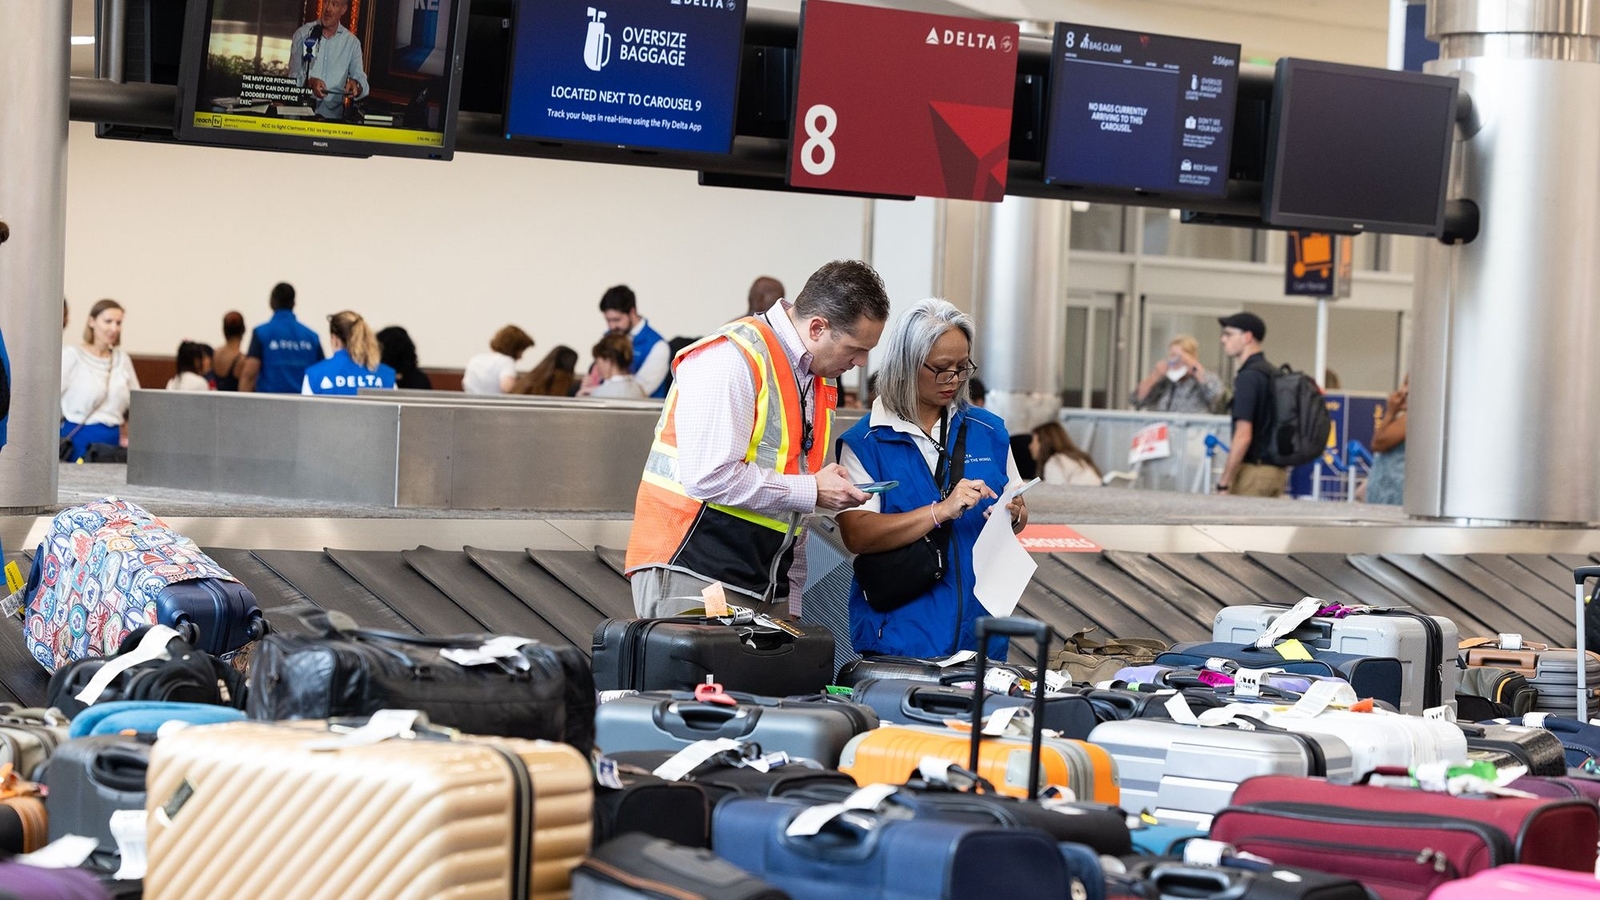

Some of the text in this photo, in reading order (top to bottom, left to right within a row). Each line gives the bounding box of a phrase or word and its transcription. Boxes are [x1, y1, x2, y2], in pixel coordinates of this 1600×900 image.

[622, 26, 686, 48] OVERSIZE
[944, 30, 996, 50] DELTA
[1066, 31, 1074, 48] 8
[620, 44, 686, 66] BAGGAGE
[1089, 41, 1122, 53] BAG CLAIM
[551, 86, 702, 112] LOCATED NEXT TO CAROUSEL 9
[1088, 102, 1148, 116] NO BAGS CURRENTLY
[547, 108, 565, 118] Track
[581, 112, 596, 122] bags
[597, 113, 603, 122] in
[604, 115, 632, 125] real-time
[633, 118, 650, 128] using
[650, 118, 660, 127] the
[662, 119, 671, 130] Fly
[672, 120, 688, 130] Delta
[688, 122, 702, 132] App
[1091, 112, 1143, 125] ARRIVING TO THIS
[800, 104, 838, 175] 8
[280, 340, 313, 350] DELTA
[335, 374, 383, 388] DELTA
[1020, 537, 1096, 548] AROUSELS
